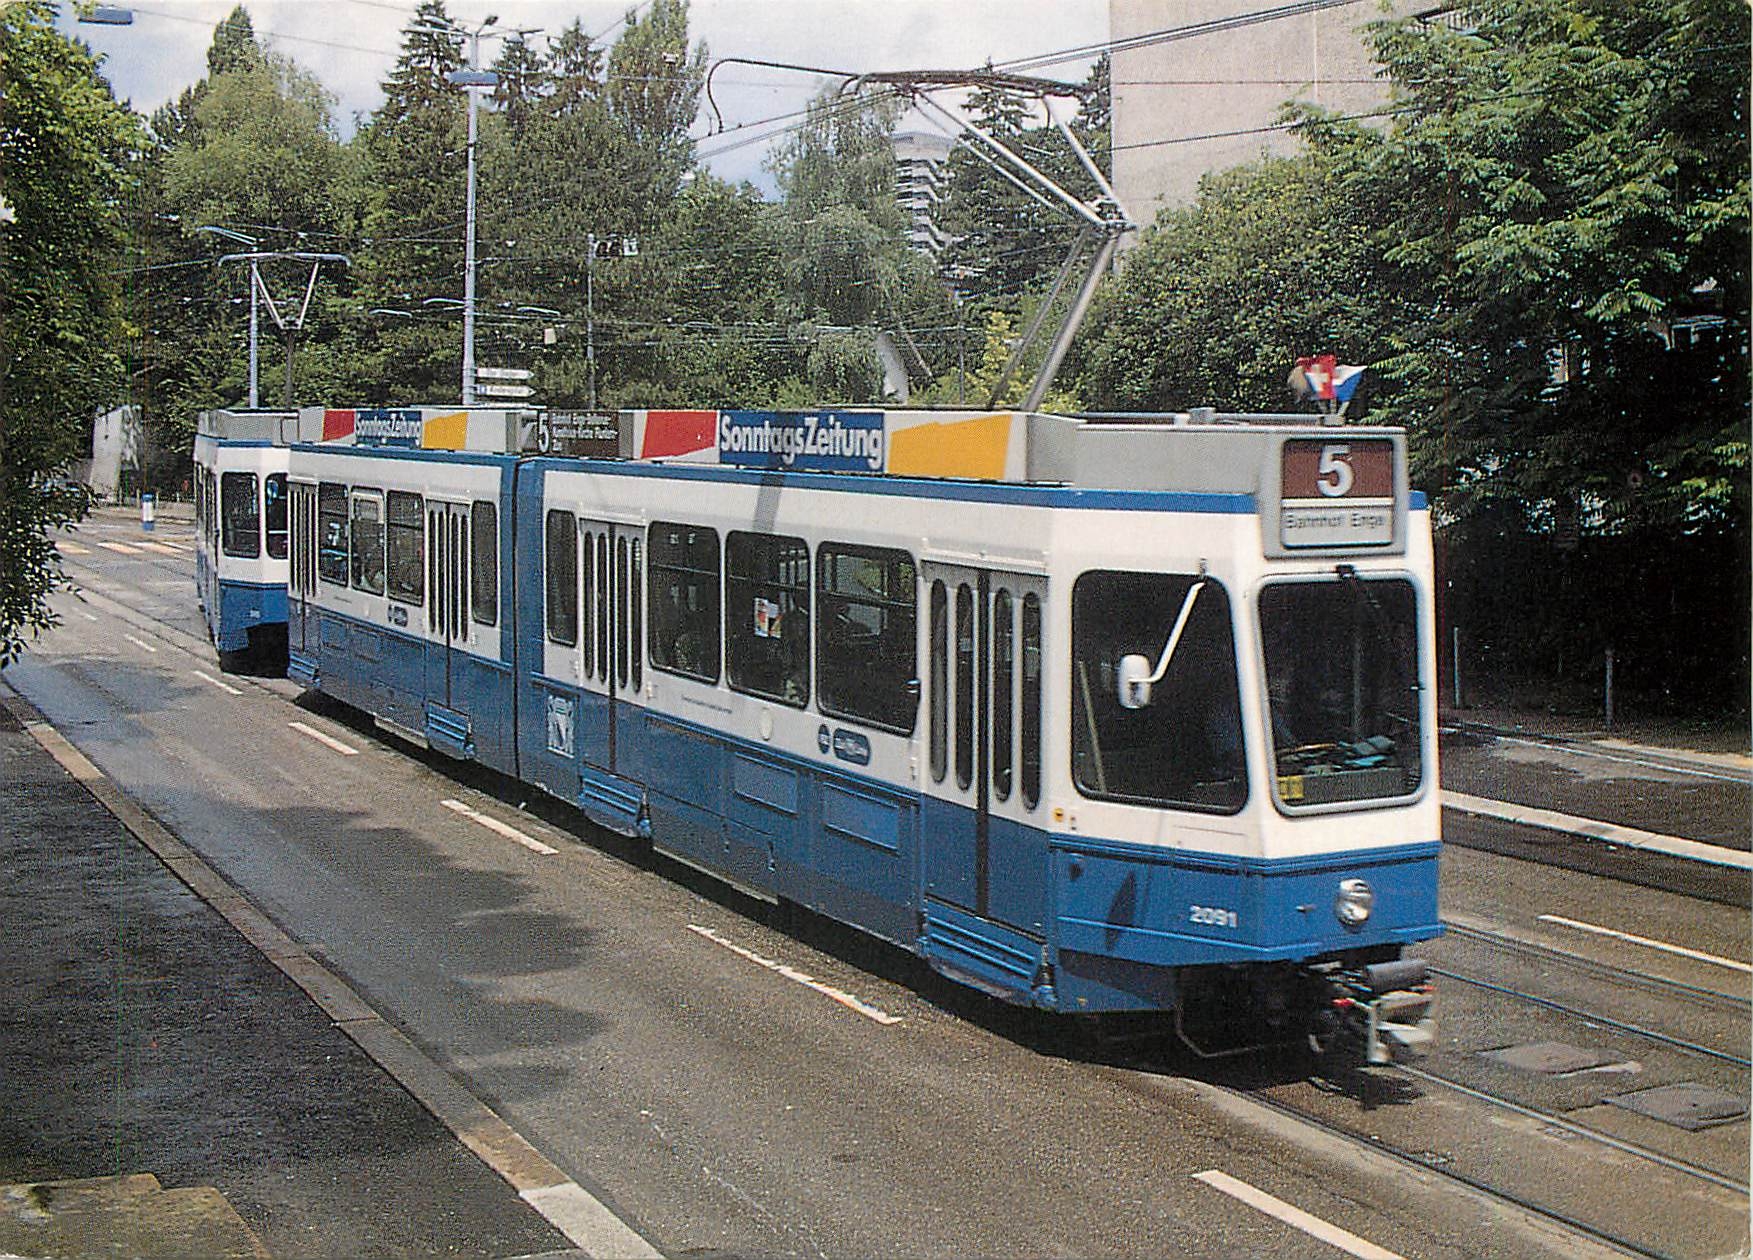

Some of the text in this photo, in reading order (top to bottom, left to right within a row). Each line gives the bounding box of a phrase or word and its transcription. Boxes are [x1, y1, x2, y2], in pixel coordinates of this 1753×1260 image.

[538, 412, 549, 453] 5
[720, 414, 884, 470] SonntagsZeitung
[1317, 444, 1354, 497] 5
[1352, 512, 1385, 529] Enge
[1189, 905, 1238, 928] 2091
